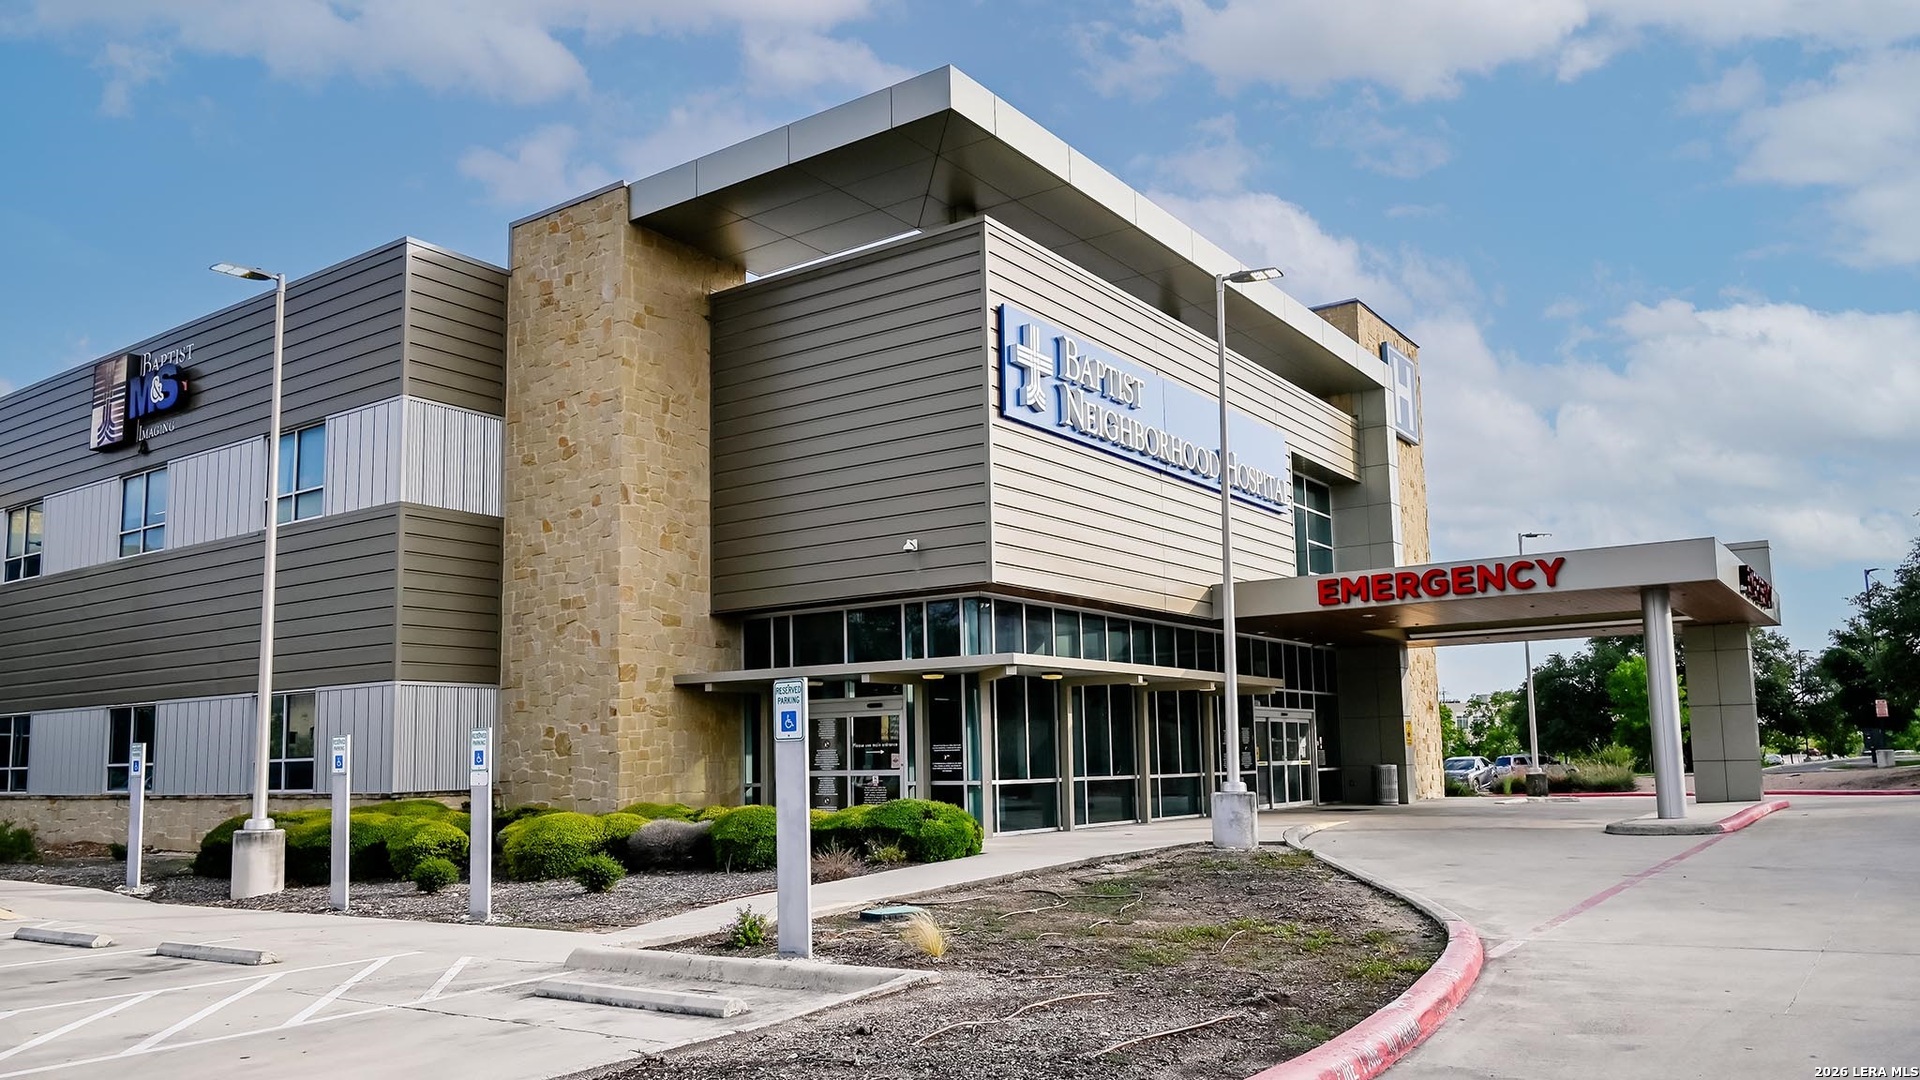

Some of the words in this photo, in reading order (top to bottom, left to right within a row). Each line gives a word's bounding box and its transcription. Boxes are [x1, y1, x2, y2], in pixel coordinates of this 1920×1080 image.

[140, 343, 195, 377] BAPTIST
[1055, 335, 1145, 410] BAPTIST
[129, 362, 179, 420] M&S
[1392, 355, 1415, 432] H
[137, 419, 175, 442] IMAGING
[1055, 381, 1221, 479] NEIGHBORHOOD
[1317, 557, 1566, 606] EMERGENCY
[775, 685, 802, 695] RESERVED
[777, 696, 800, 705] PARKING
